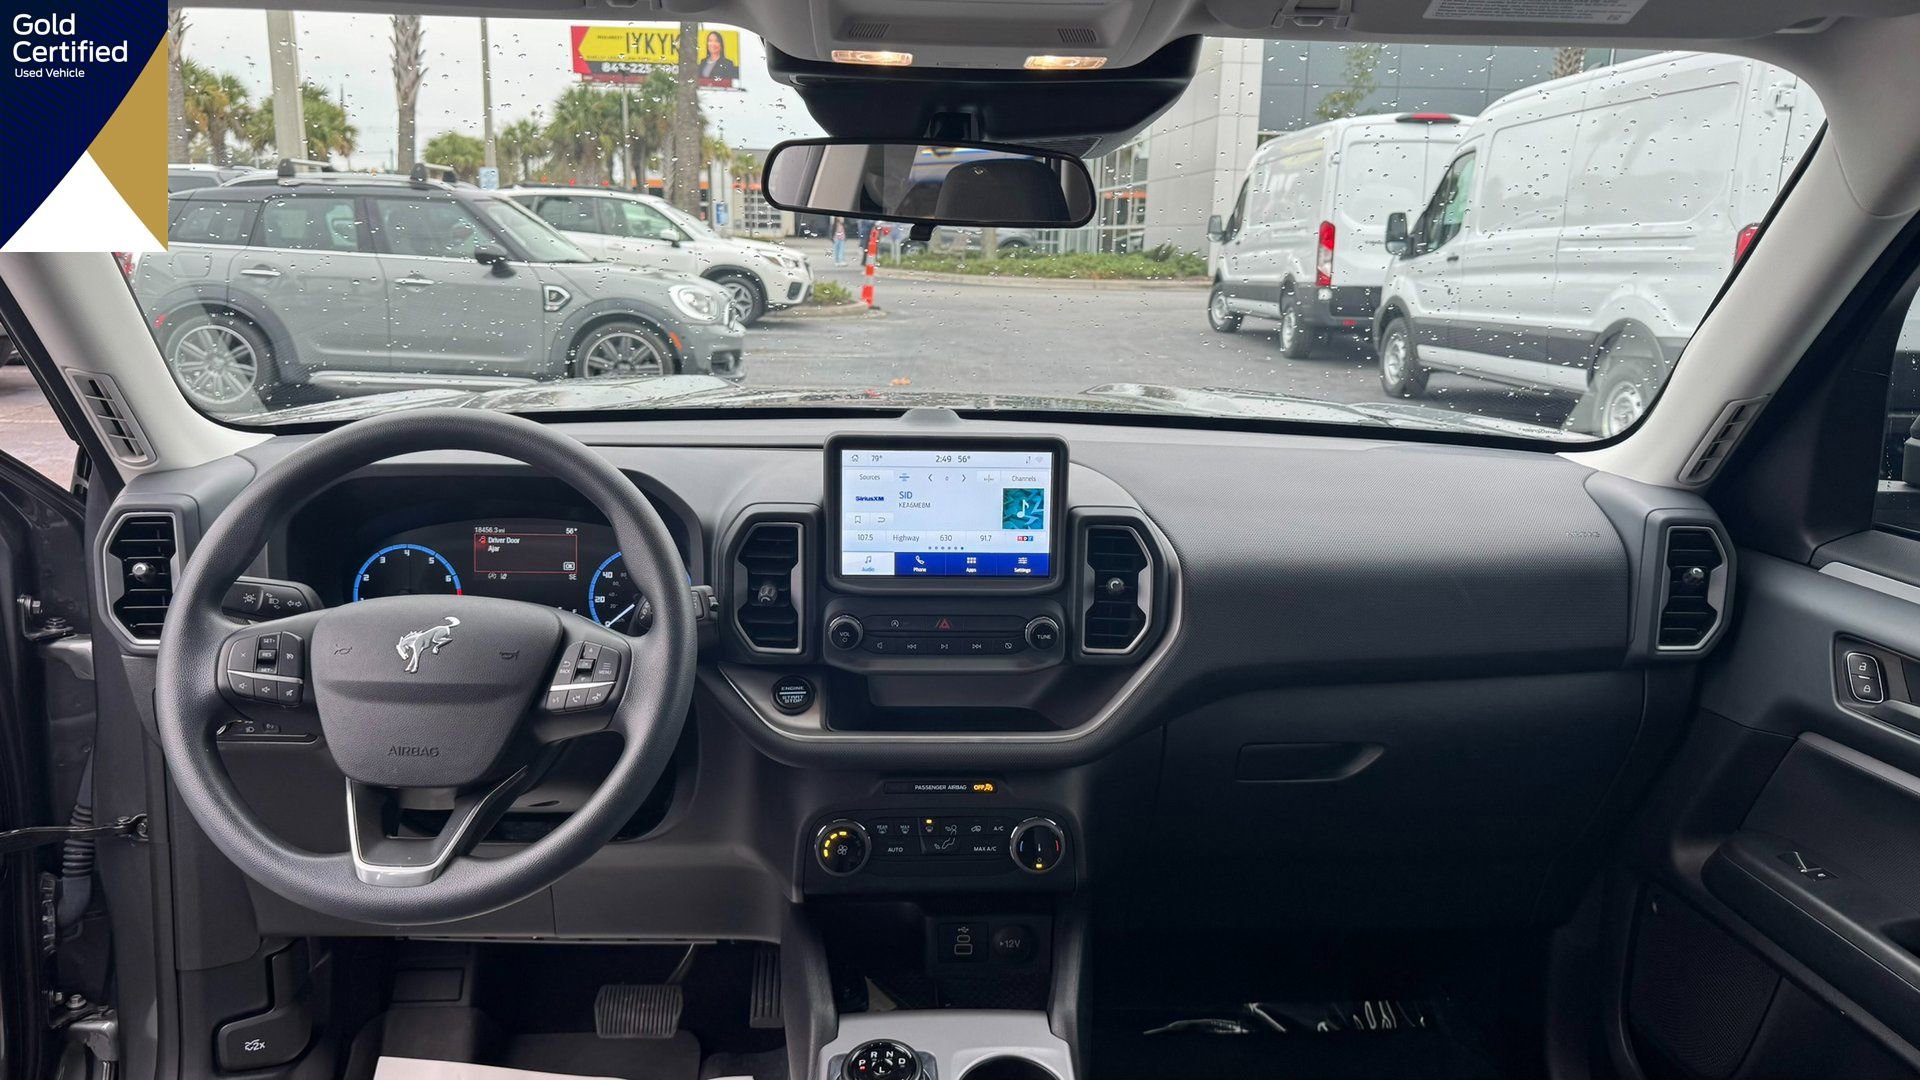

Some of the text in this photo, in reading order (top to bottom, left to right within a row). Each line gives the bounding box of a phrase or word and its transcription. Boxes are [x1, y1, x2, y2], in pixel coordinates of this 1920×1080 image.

[935, 455, 952, 463] 2:49
[859, 473, 881, 481] Sources
[898, 490, 913, 500] SID
[487, 536, 520, 545] Driver Door
[857, 534, 874, 542] 107.5
[892, 534, 920, 543] Highway
[939, 534, 953, 542] 630
[979, 534, 993, 543] 91.7
[487, 545, 501, 553] Ajar
[380, 556, 386, 564] 3
[861, 565, 876, 573] Audio
[1013, 566, 1032, 575] Settings
[602, 571, 613, 579] 40
[839, 630, 850, 638] VOL
[388, 746, 439, 757] AIRBAG
